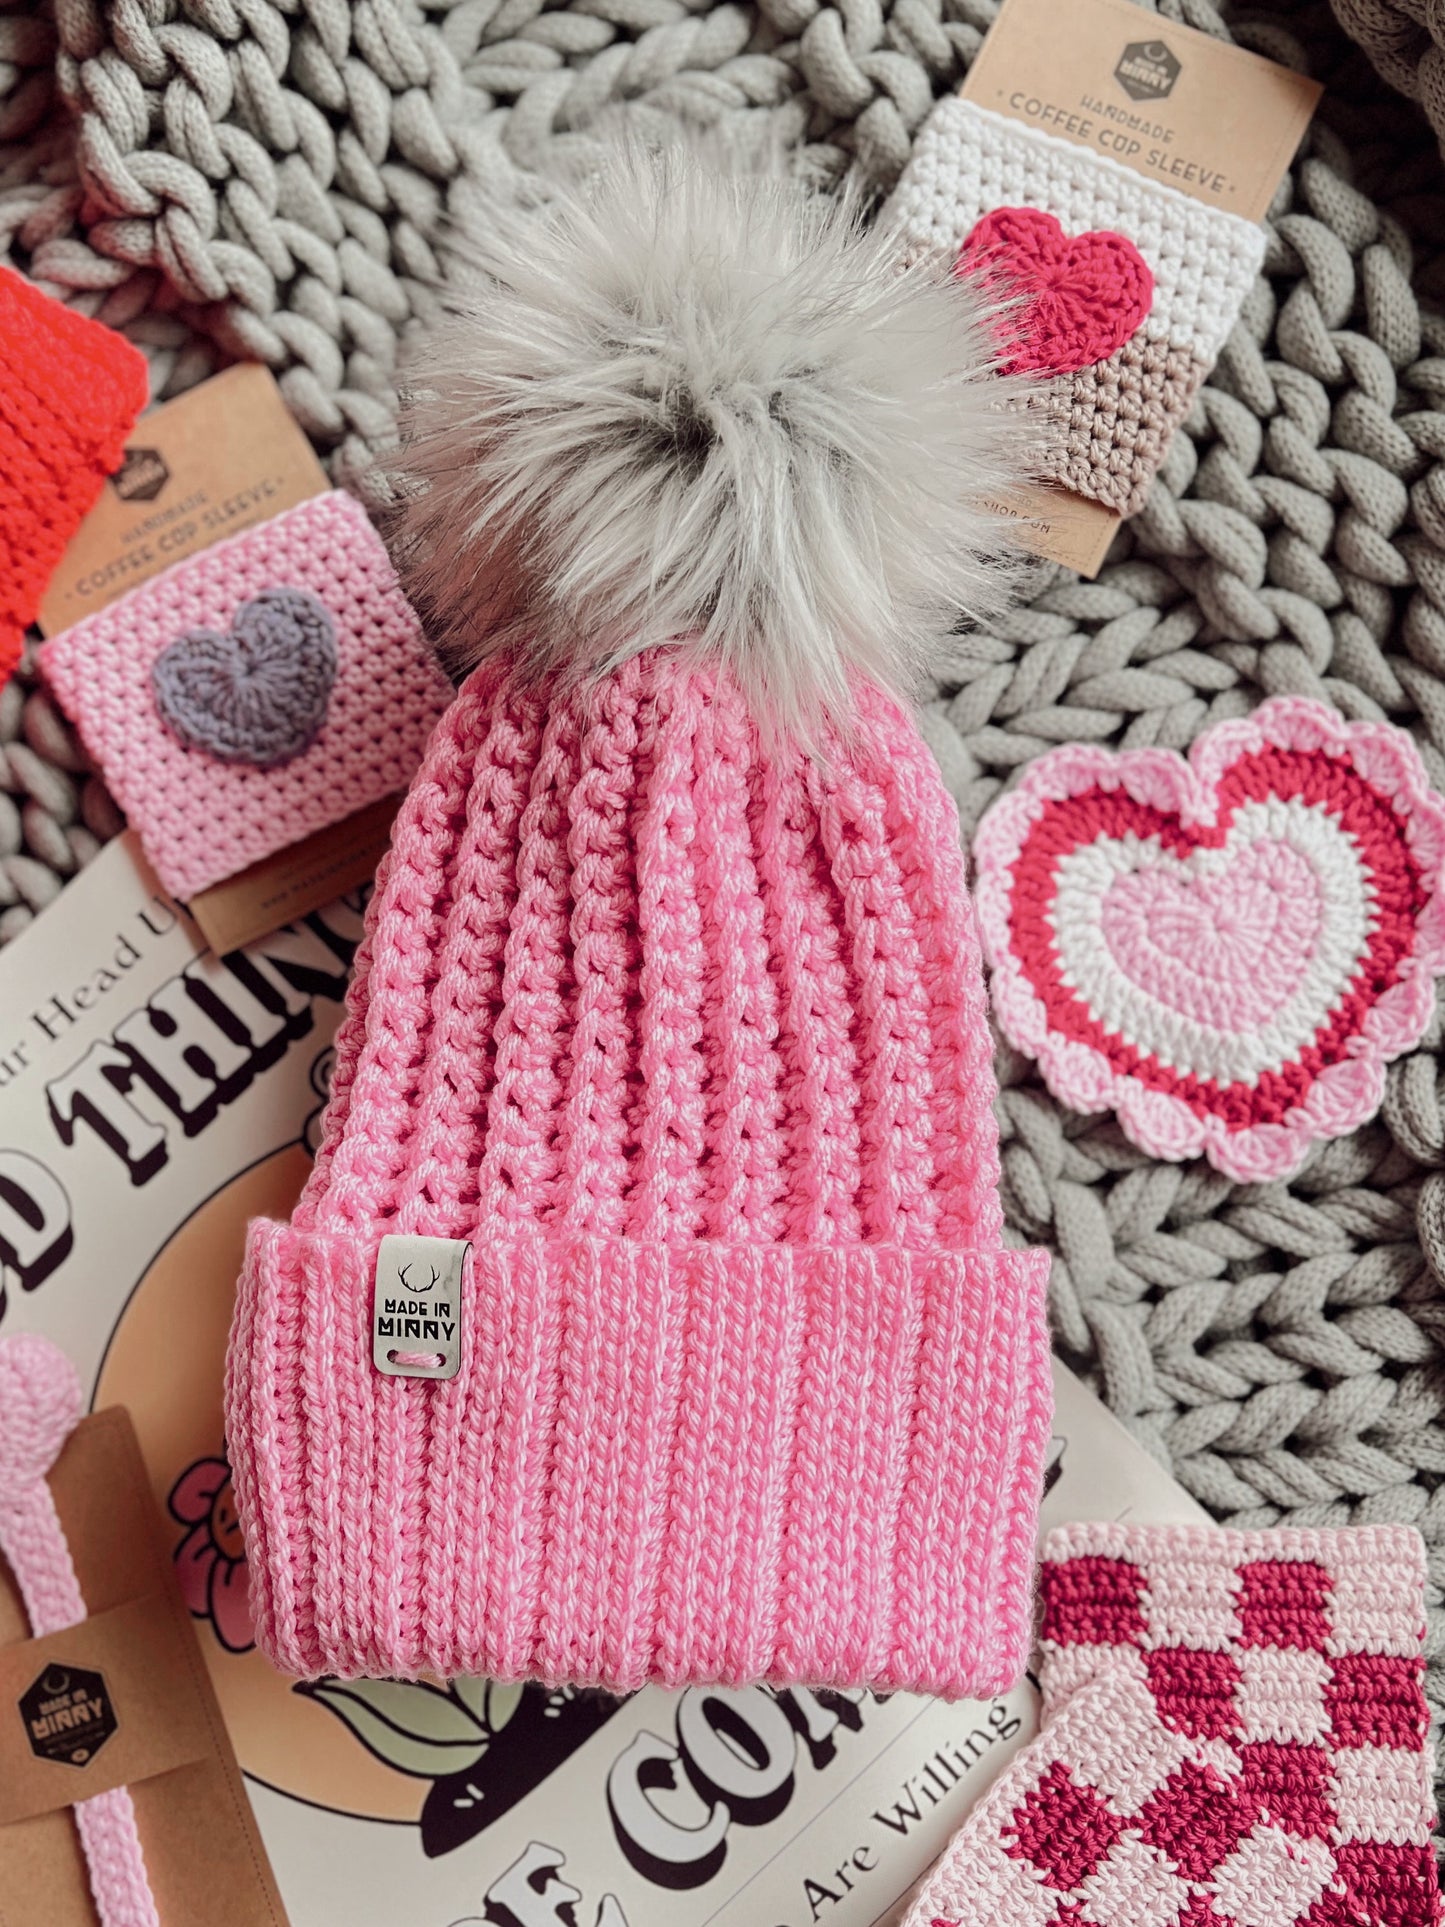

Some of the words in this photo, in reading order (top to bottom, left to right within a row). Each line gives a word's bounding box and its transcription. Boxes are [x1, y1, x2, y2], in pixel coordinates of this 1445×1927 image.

[1009, 92, 1093, 138] COFFEE
[1098, 129, 1141, 156] CUP
[1146, 150, 1227, 193] SLEEVE
[1080, 95, 1175, 144] HANDMADE
[76, 544, 154, 596] COFFEE
[158, 519, 198, 553] CUP
[202, 478, 275, 530] SLEEVE
[33, 932, 142, 1040] Head
[378, 1316, 455, 1341] MINNY
[385, 1299, 427, 1316] MADE
[434, 1302, 450, 1318] IN
[31, 1697, 102, 1739] MINNY
[803, 1846, 880, 1923] Are
[870, 1698, 1021, 1836] Willing
